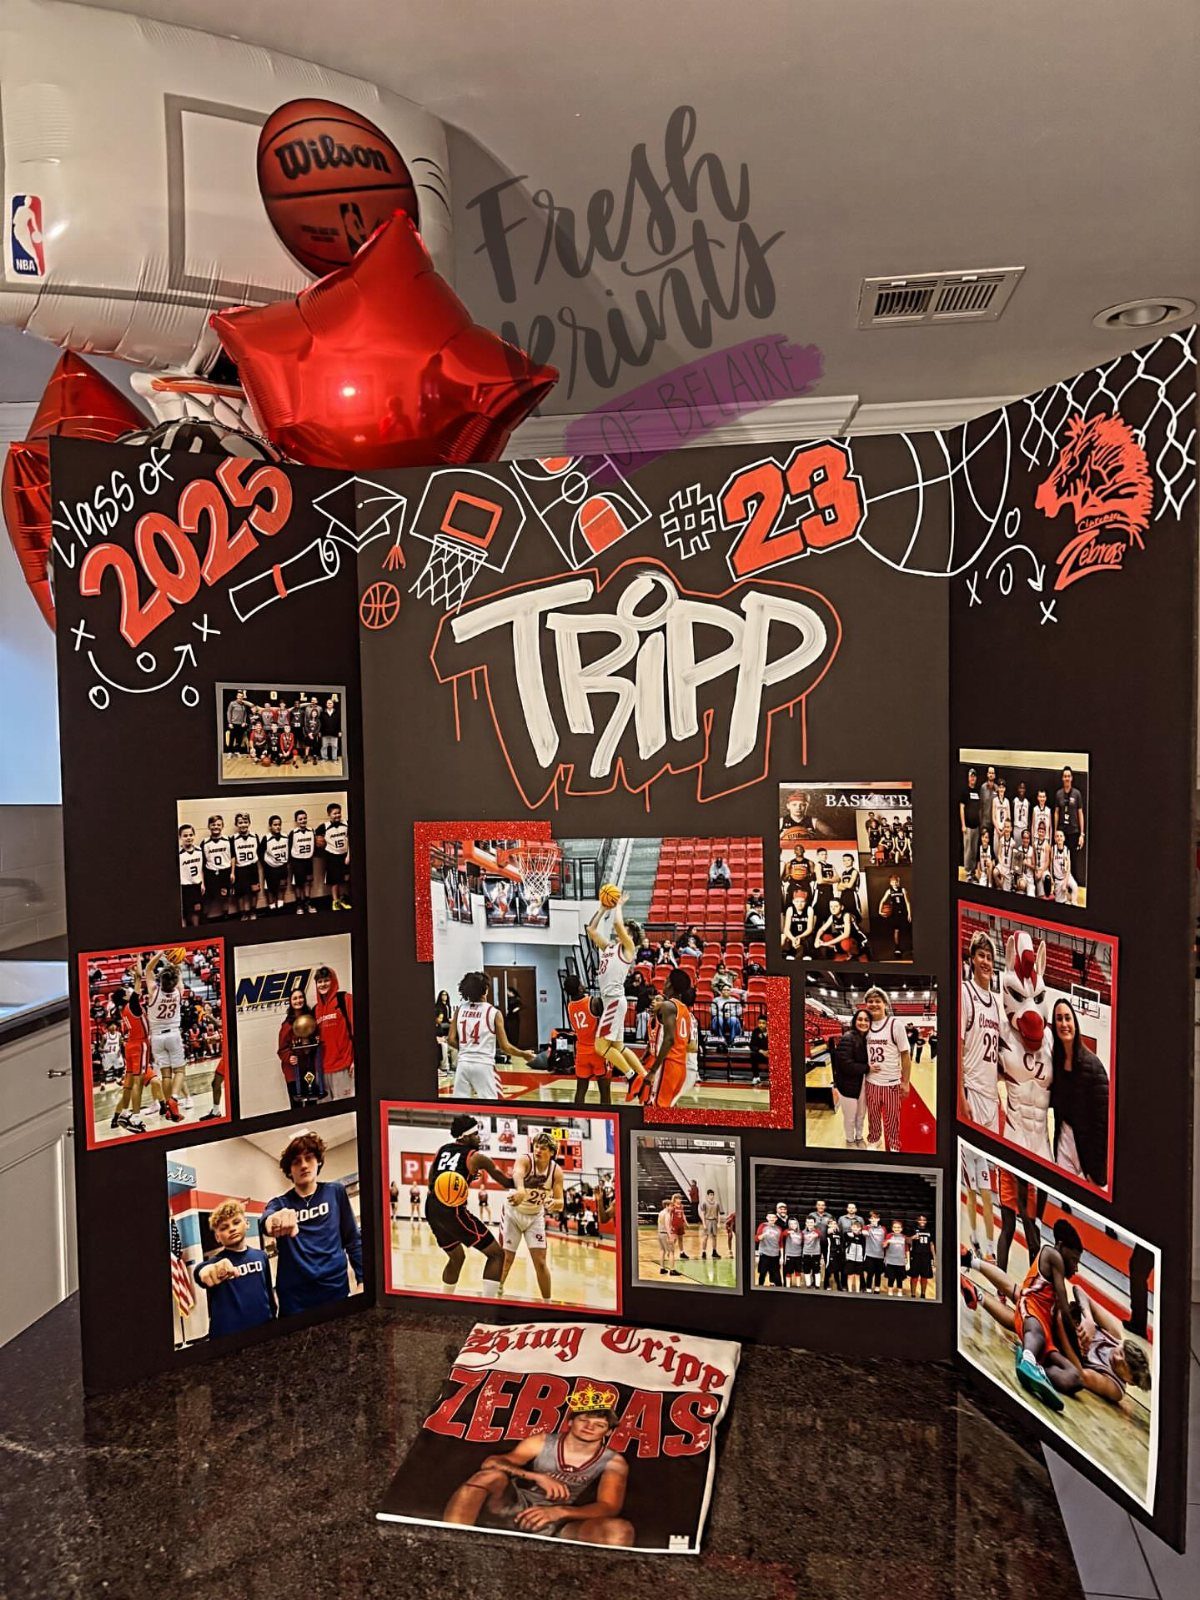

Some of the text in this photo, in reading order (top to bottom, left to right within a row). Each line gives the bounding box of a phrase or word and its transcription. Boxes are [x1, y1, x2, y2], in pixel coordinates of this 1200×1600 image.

[274, 134, 391, 180] Wilson
[15, 259, 36, 271] NBA
[139, 446, 175, 496] of
[79, 456, 293, 648] 2025
[1054, 529, 1127, 591] Zebras
[825, 794, 912, 808] BASKETB
[239, 851, 254, 862] 30
[156, 1003, 177, 1020] 23
[238, 1000, 290, 1012] ATHLETIC
[573, 1011, 589, 1029] 12
[459, 1019, 481, 1045] 14
[870, 1046, 885, 1063] 23
[982, 1032, 998, 1064] 23
[437, 1151, 461, 1172] 24
[296, 1202, 330, 1223] OCO
[452, 1324, 730, 1393] King Tripp
